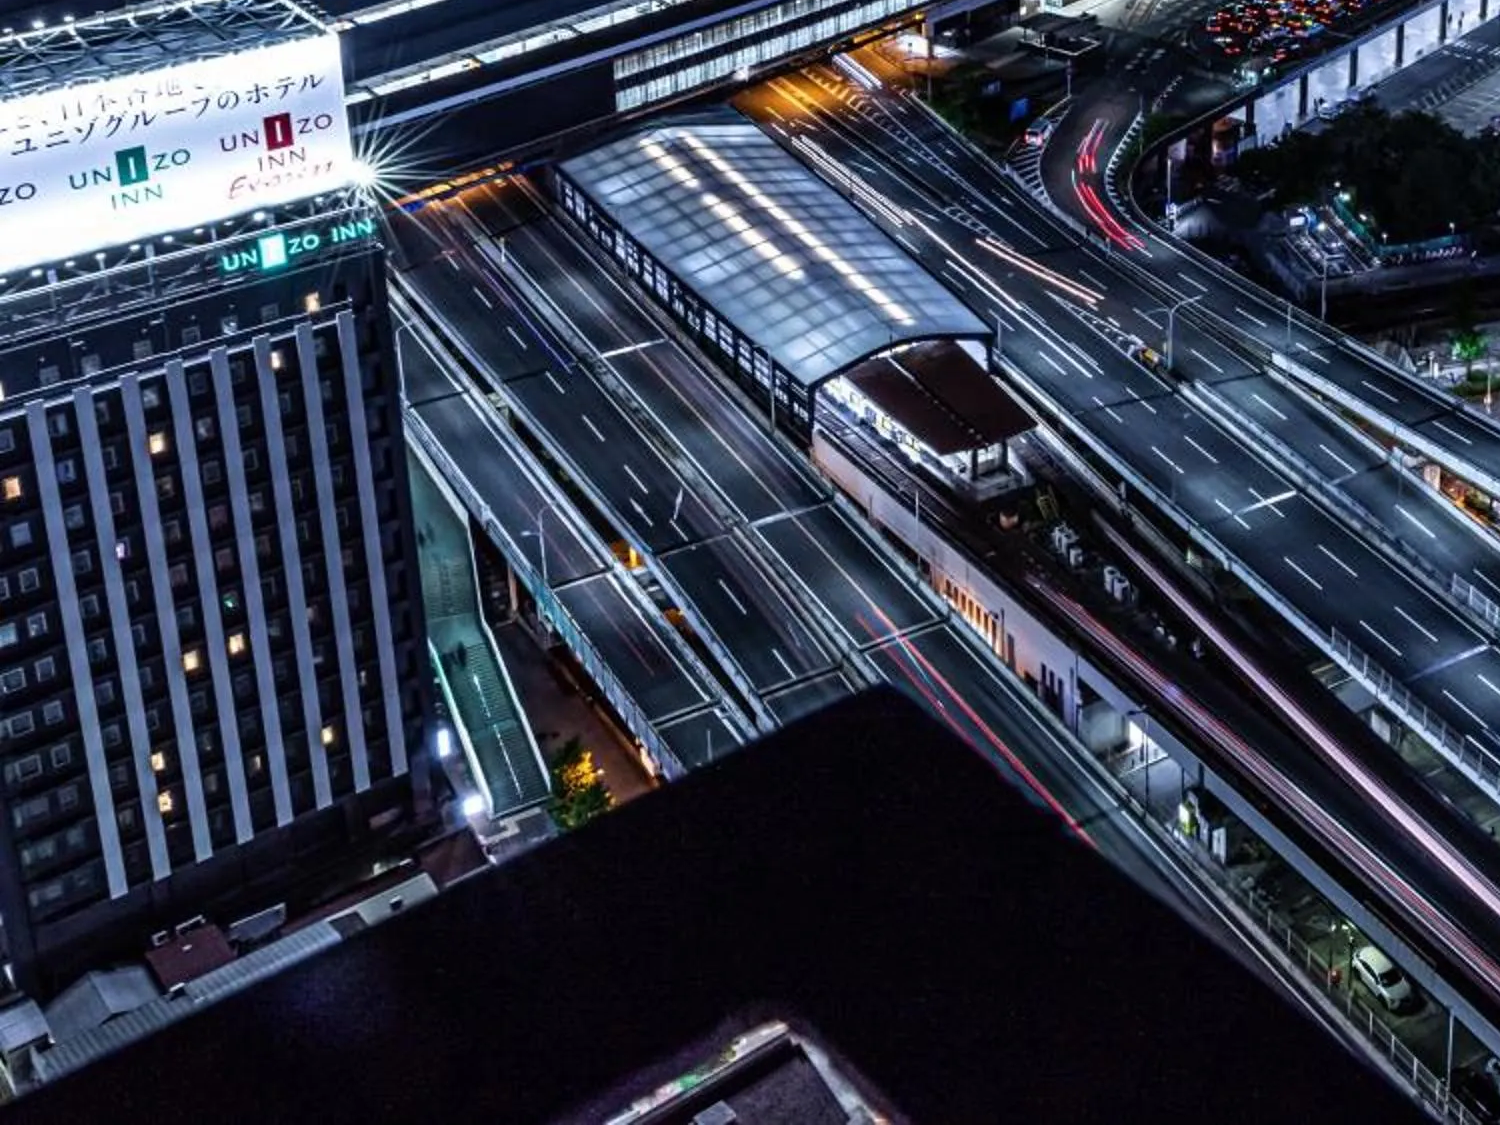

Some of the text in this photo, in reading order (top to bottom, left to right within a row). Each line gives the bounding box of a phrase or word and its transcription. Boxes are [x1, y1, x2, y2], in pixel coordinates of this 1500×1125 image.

[219, 111, 333, 153] UNIZO
[68, 144, 191, 191] UNIZO
[258, 147, 306, 172] INN
[111, 184, 164, 211] INN
[221, 218, 373, 272] UNIZO INN
